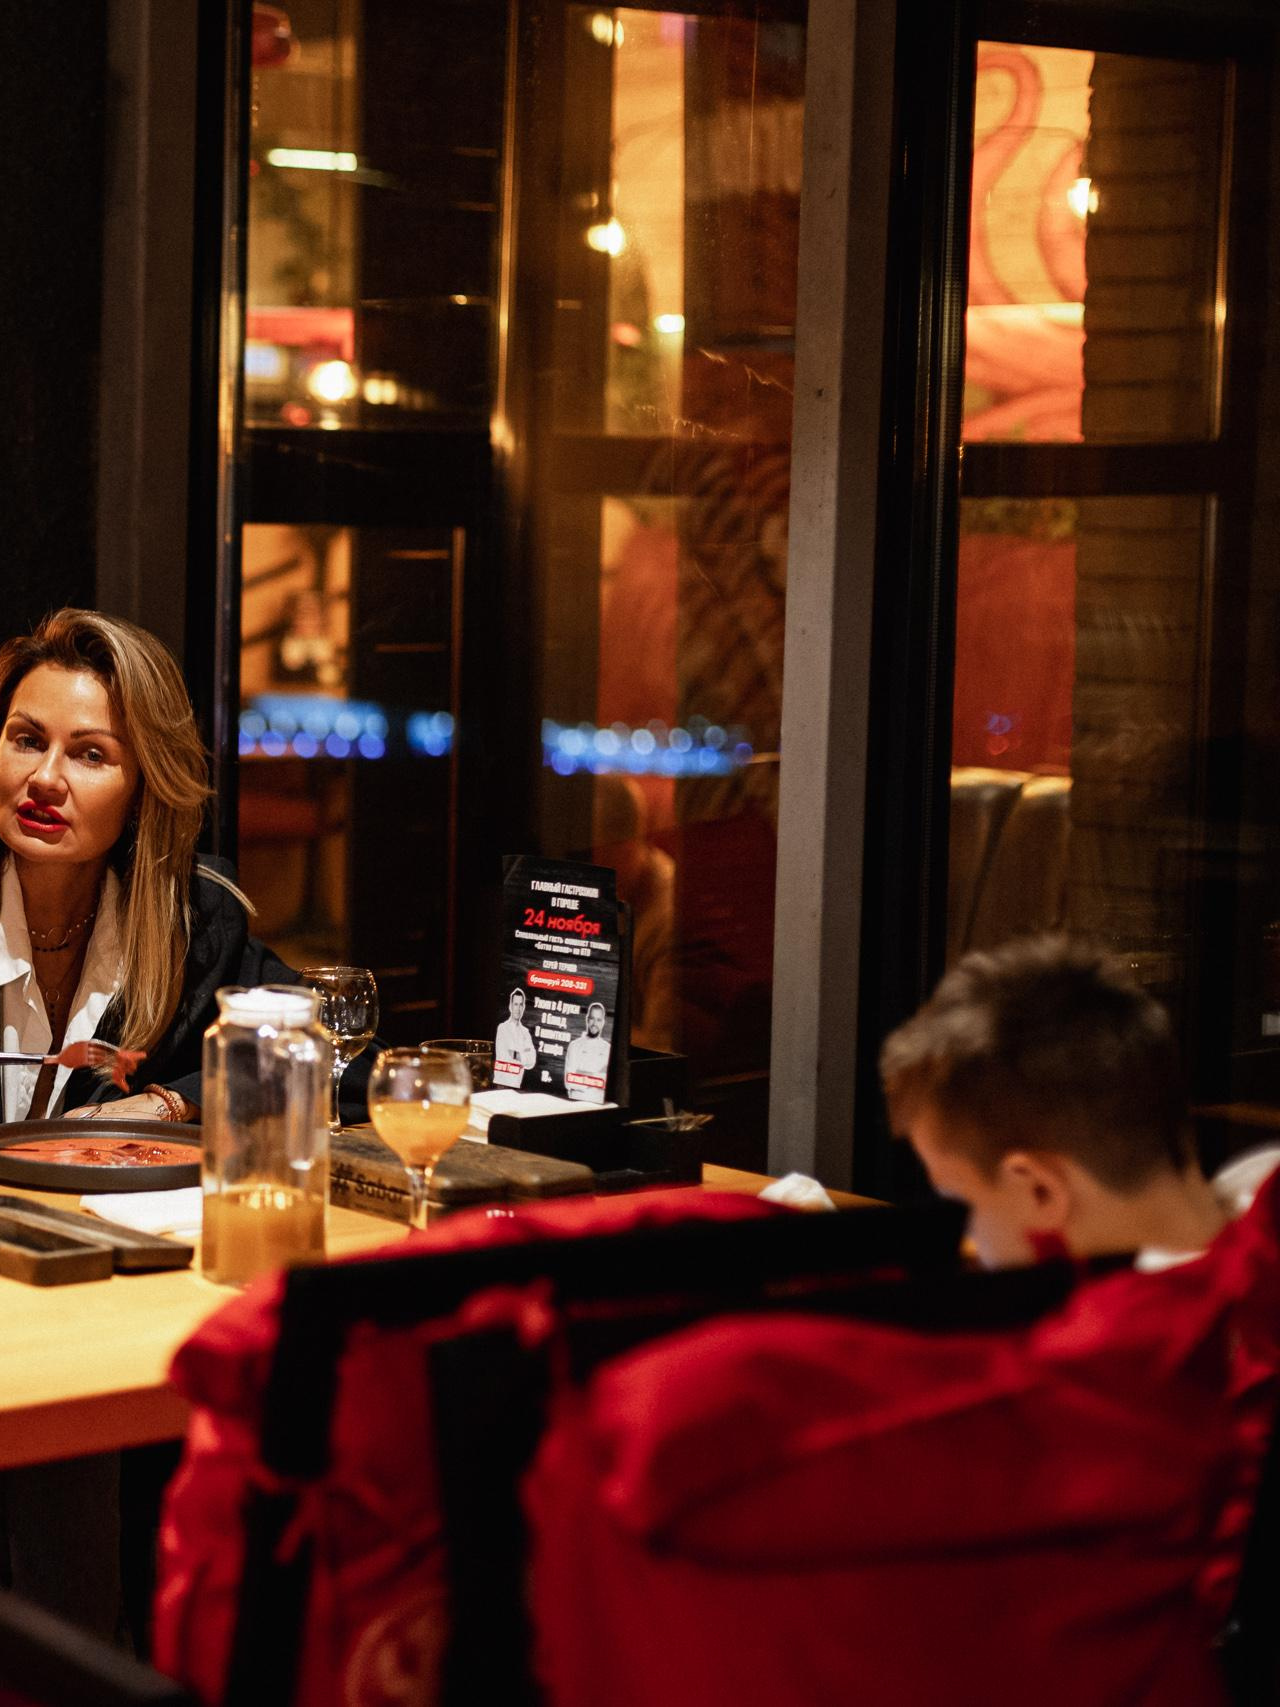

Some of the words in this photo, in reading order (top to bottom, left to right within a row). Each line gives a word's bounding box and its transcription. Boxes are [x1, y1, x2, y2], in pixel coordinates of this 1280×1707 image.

[524, 908, 545, 927] 24
[547, 914, 601, 939] ноября
[557, 1000, 563, 1011] 4
[538, 1040, 544, 1052] 2
